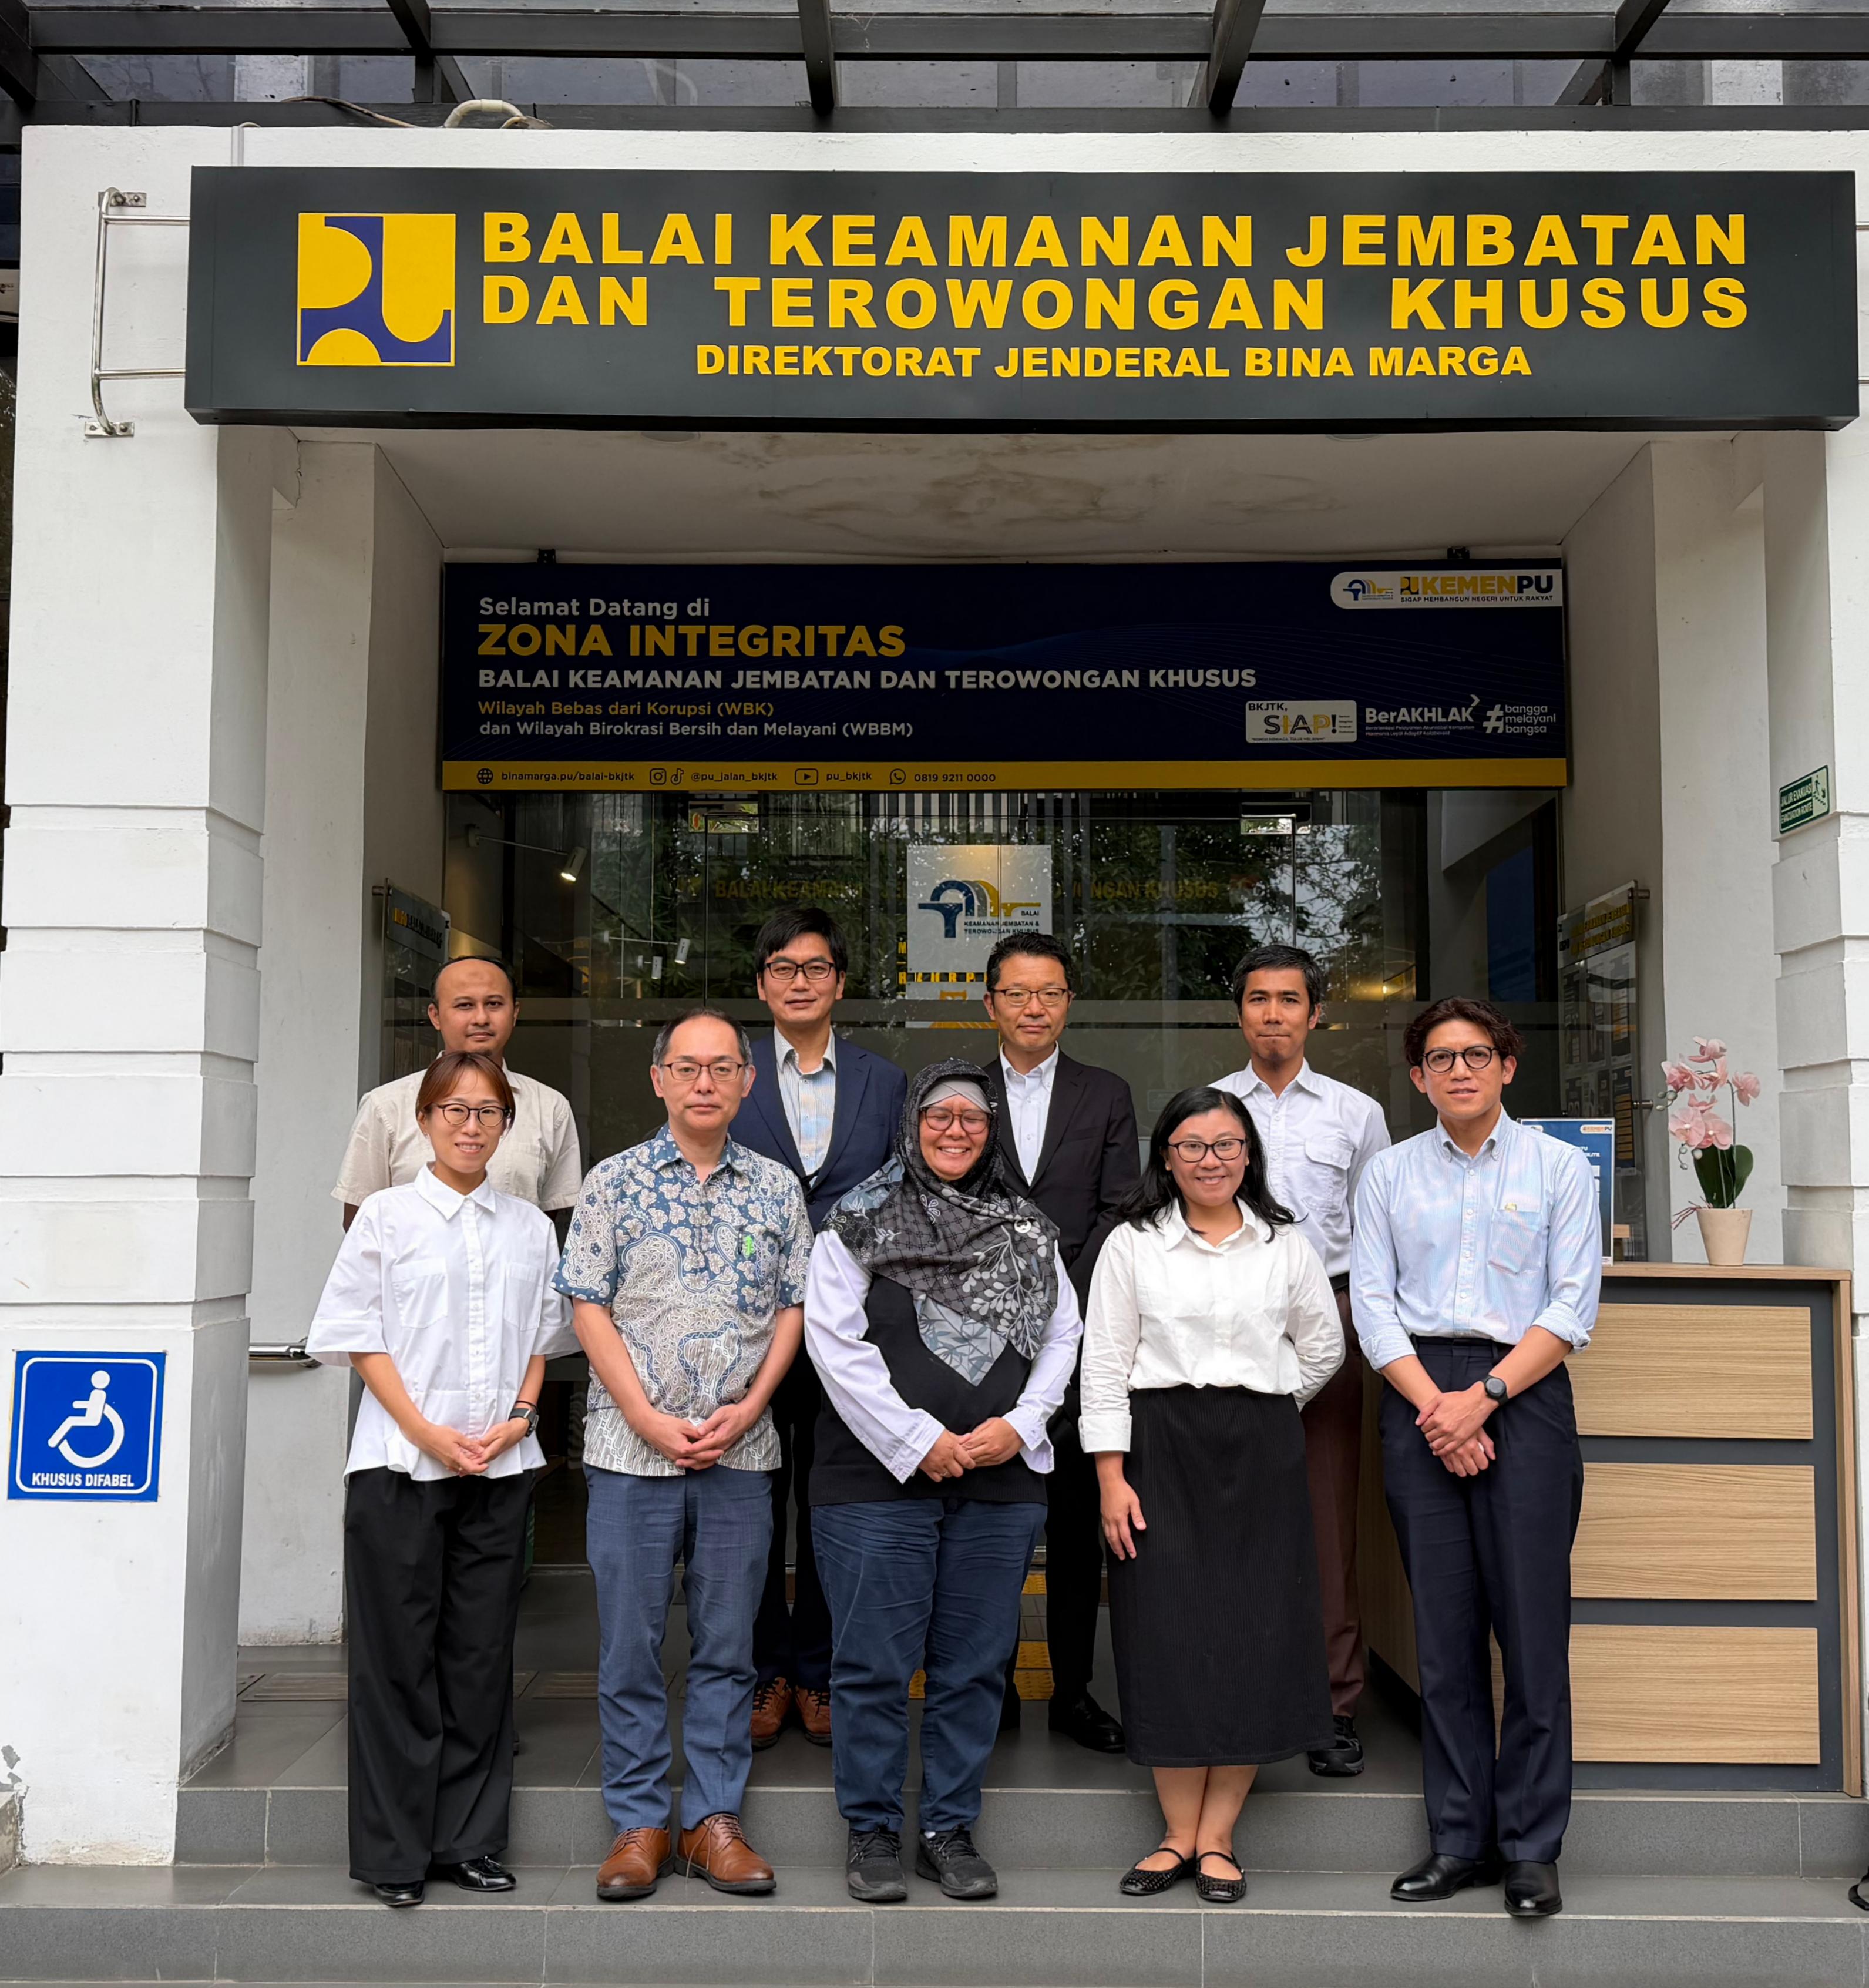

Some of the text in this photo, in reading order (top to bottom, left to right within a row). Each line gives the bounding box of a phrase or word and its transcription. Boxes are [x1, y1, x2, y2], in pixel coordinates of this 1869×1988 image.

[484, 212, 1744, 267] BALAI KEAMANAN JEMBATAN
[483, 276, 1747, 330] DAN TEROWONGAN KHUSUS
[697, 345, 1531, 377] DIREKTORAT JENDERAL BINA MARGA
[1420, 575, 1554, 595] KEMENPU
[480, 597, 709, 619] Selamat Datang di
[478, 624, 905, 657] ZONA INTEGRITAS
[479, 669, 1256, 688] BALAI KEAMANAN JEMBATAN DAN TEROWONGAN KHUSUS
[478, 701, 773, 717] Wilayah Bebas dari Korupsi (WBK)
[1249, 703, 1287, 711] BKJTK,
[1366, 707, 1474, 723] BerAKHLAK
[1505, 705, 1547, 714] bangga
[1263, 714, 1337, 734] SIAP!
[1505, 713, 1555, 724] melayani
[480, 721, 912, 737] dan Wilayah Birokrasi Bersih dan Melayani (WBBM)
[1506, 723, 1546, 735] bangsa
[502, 771, 634, 781] binamarga.pu/balai-bkjtk
[691, 772, 777, 782] @pu_jalan_bkjtk
[826, 772, 872, 781] pu_bkjtk
[915, 774, 996, 782] 0819 9211 0000
[32, 1473, 134, 1487] KHUSUS DIFABEL
